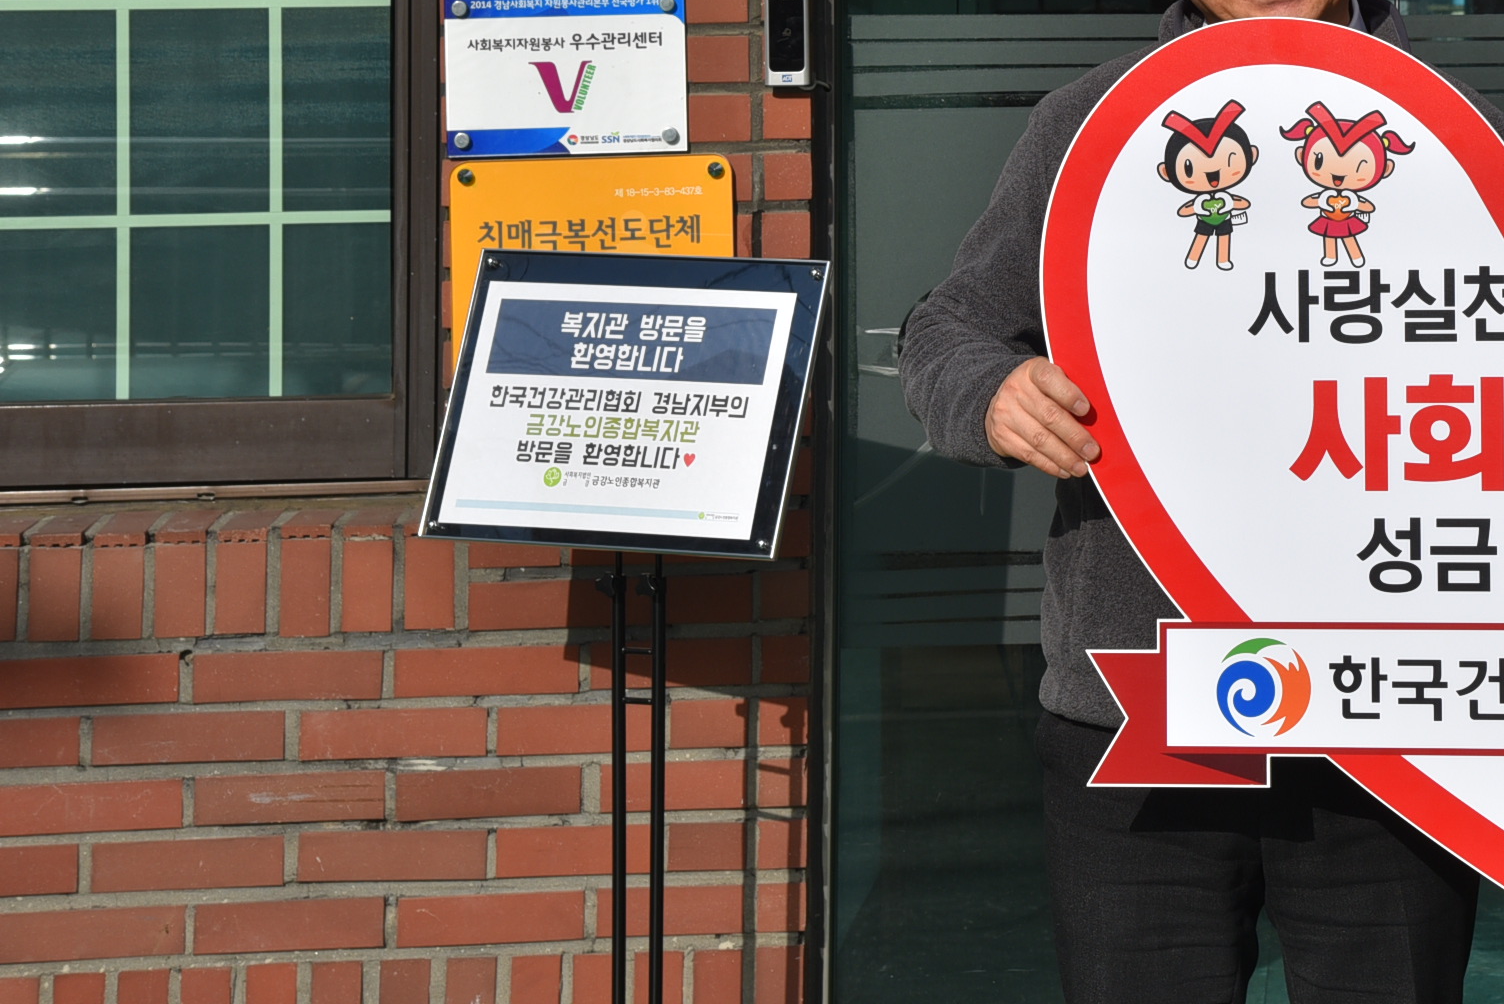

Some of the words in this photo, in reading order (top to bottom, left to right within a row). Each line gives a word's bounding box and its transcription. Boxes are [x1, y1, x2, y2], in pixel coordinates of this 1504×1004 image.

[470, 1, 492, 10] 2014
[494, 0, 543, 11] 경남사회복지
[467, 36, 565, 52] 사회복지자원봉사
[569, 31, 663, 51] 우수관리센터
[573, 64, 597, 110] VOLUNTEER
[601, 136, 620, 144] SSN
[614, 188, 624, 197] 제
[477, 213, 701, 251] 치매극복선도단체
[560, 312, 629, 340] 복지관
[639, 314, 706, 342] 방문을
[571, 342, 684, 374] 환영합니다
[489, 384, 641, 413] 한국건강관리협회
[651, 391, 750, 419] 경남지부의
[525, 413, 701, 444] 금강노인종합복지관
[516, 440, 573, 464] 방문을
[582, 442, 681, 470] 환영합니다
[592, 475, 661, 490] 금강노인종합복지관
[1357, 517, 1498, 593] 성금
